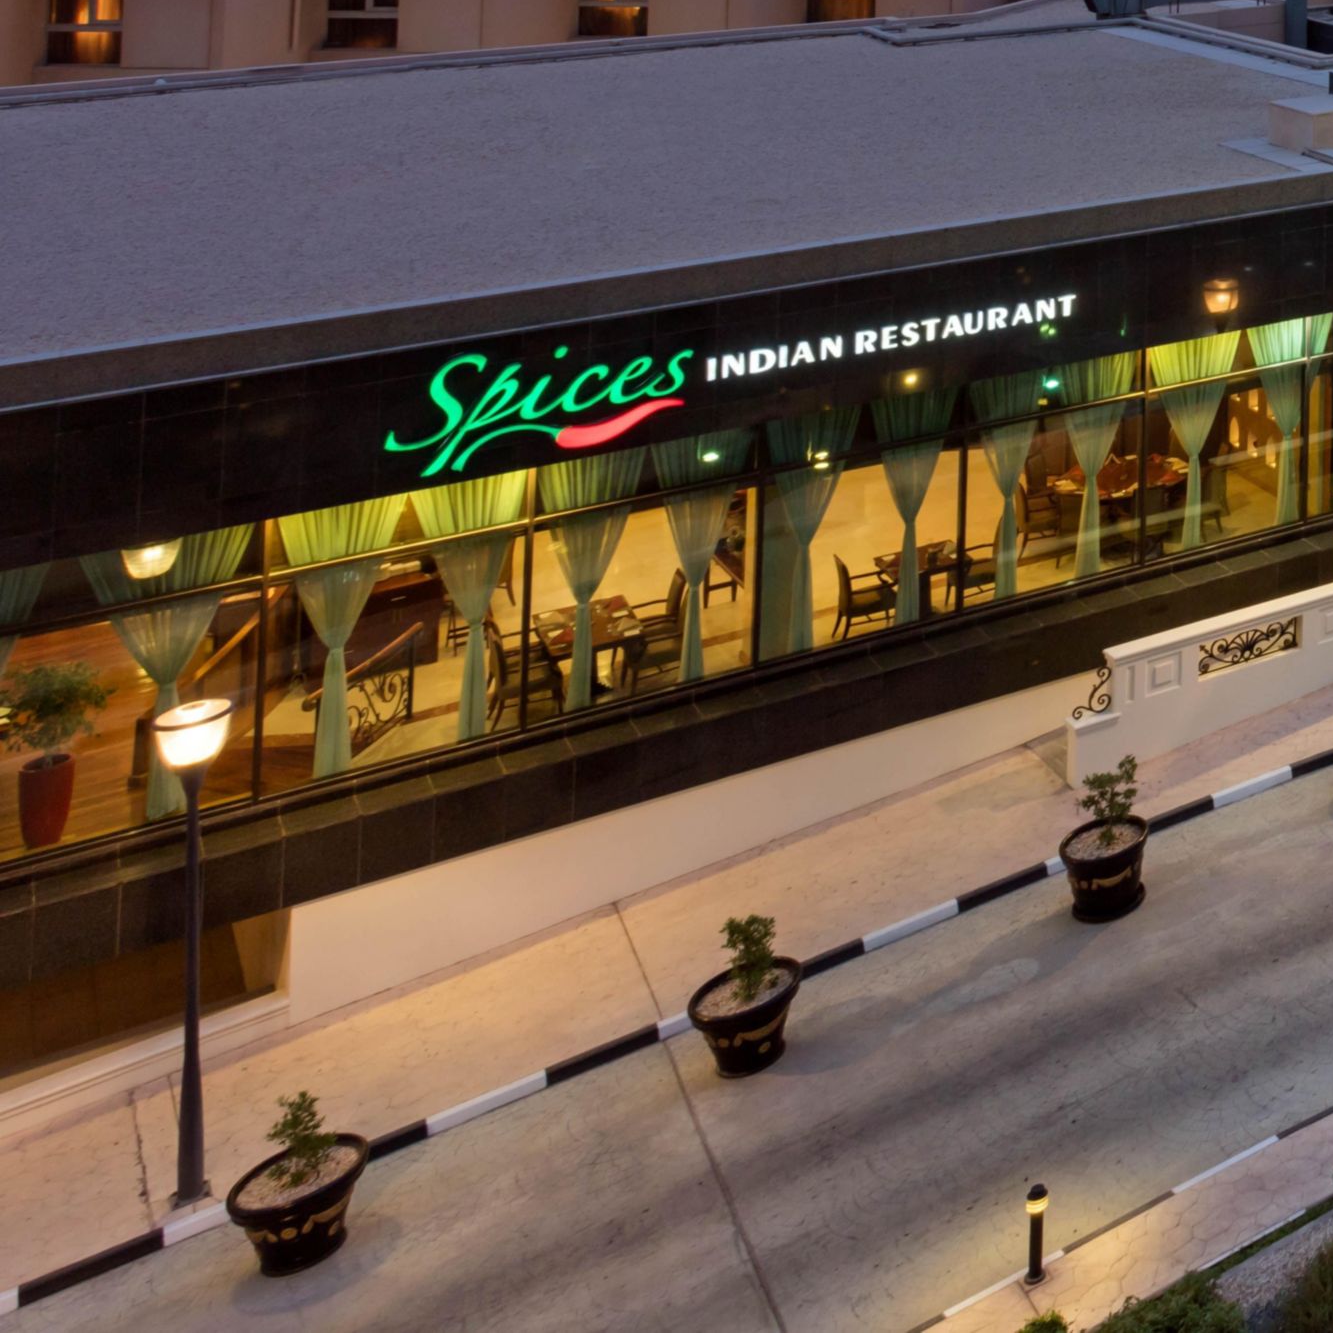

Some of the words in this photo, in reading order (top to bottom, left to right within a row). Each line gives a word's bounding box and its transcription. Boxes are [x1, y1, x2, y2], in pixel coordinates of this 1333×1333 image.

[384, 346, 694, 478] Spices
[706, 335, 843, 382] INDIAN
[854, 294, 1077, 356] RESTAURANT
